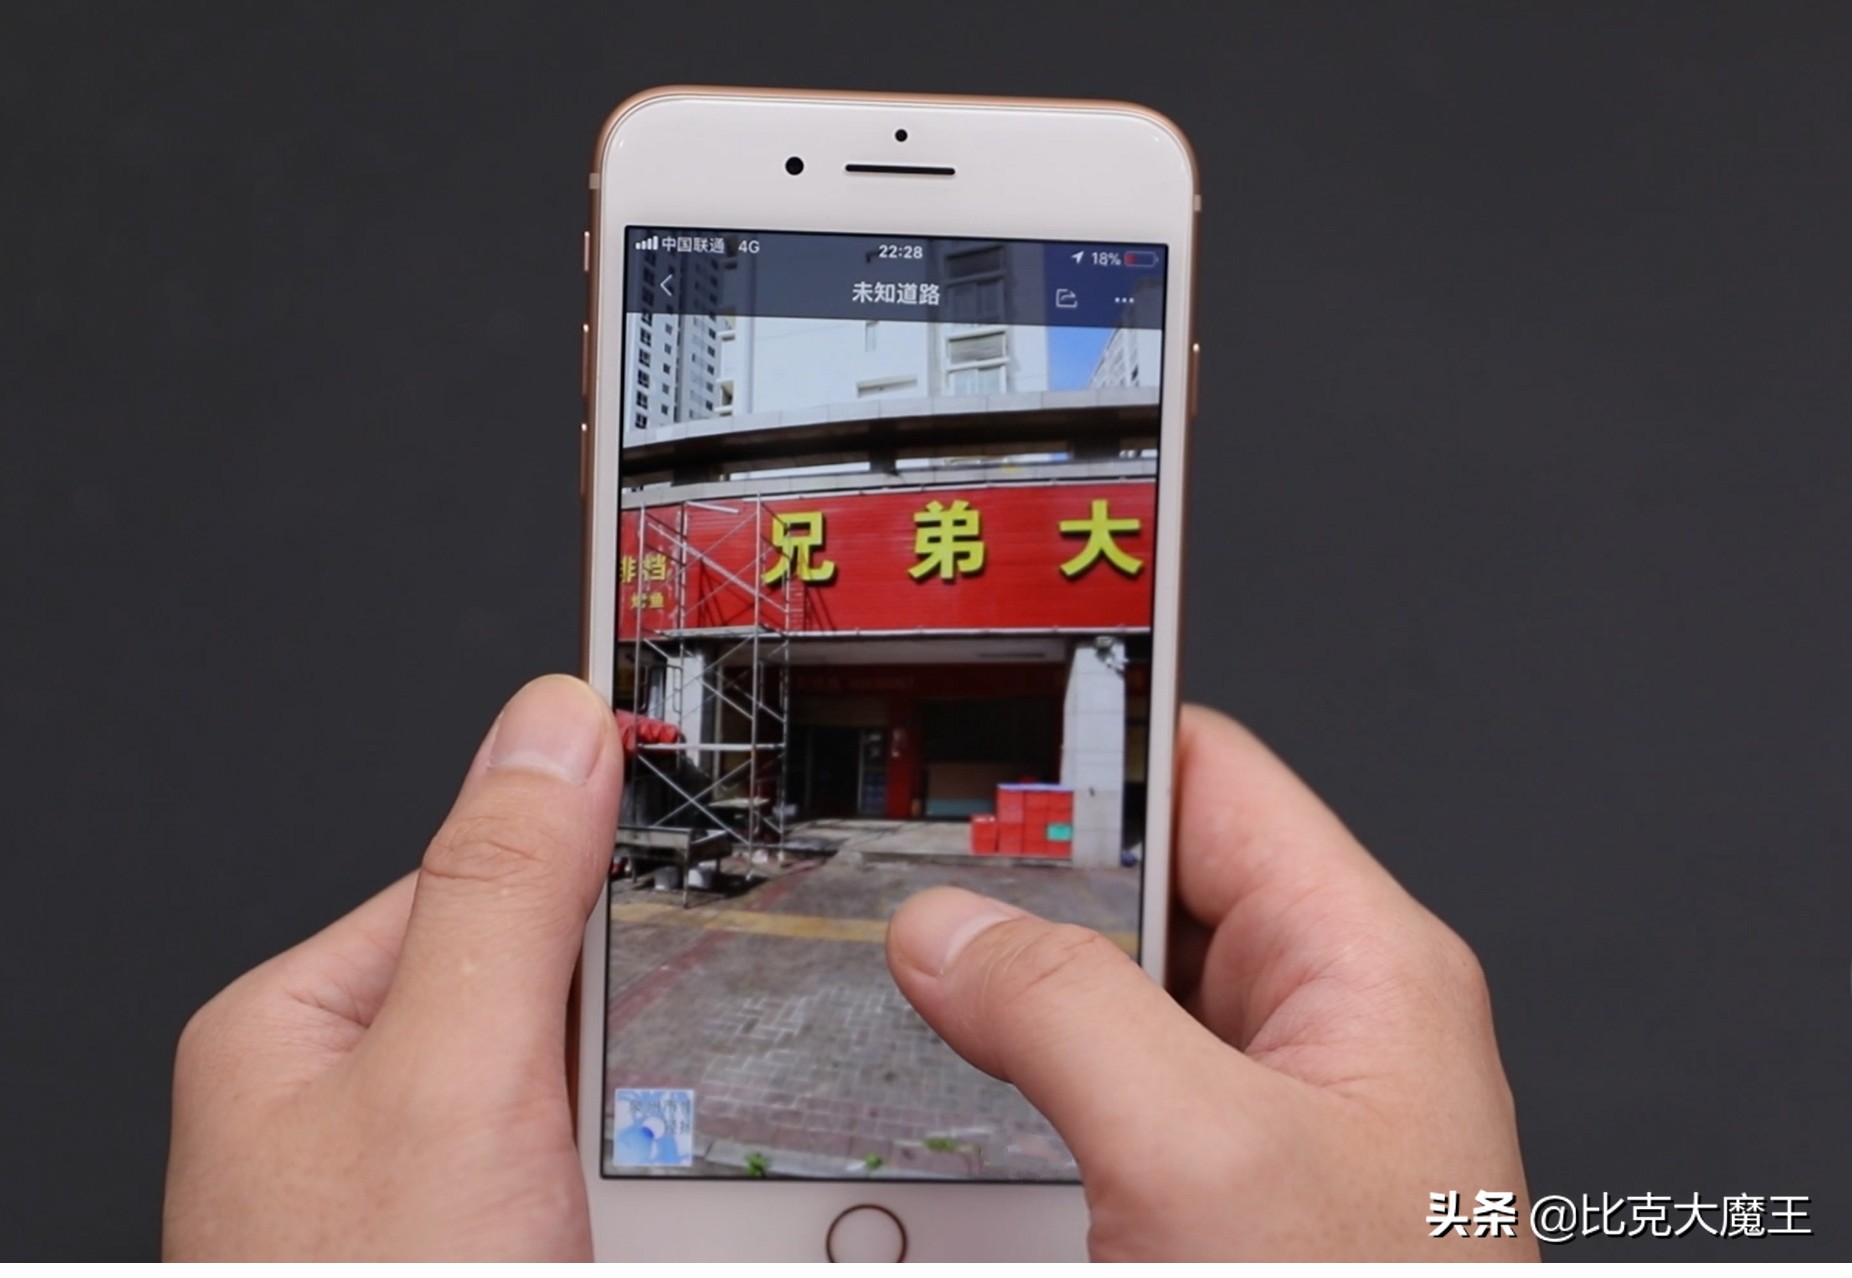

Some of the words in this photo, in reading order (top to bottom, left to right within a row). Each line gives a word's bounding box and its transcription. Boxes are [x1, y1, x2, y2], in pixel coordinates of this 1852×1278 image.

[661, 236, 725, 253] 中国联通
[738, 240, 760, 253] 4G
[878, 244, 923, 259] 22:28
[1092, 251, 1121, 266] 18%
[852, 281, 940, 306] 未知道路
[762, 500, 1144, 586] 兄弟大
